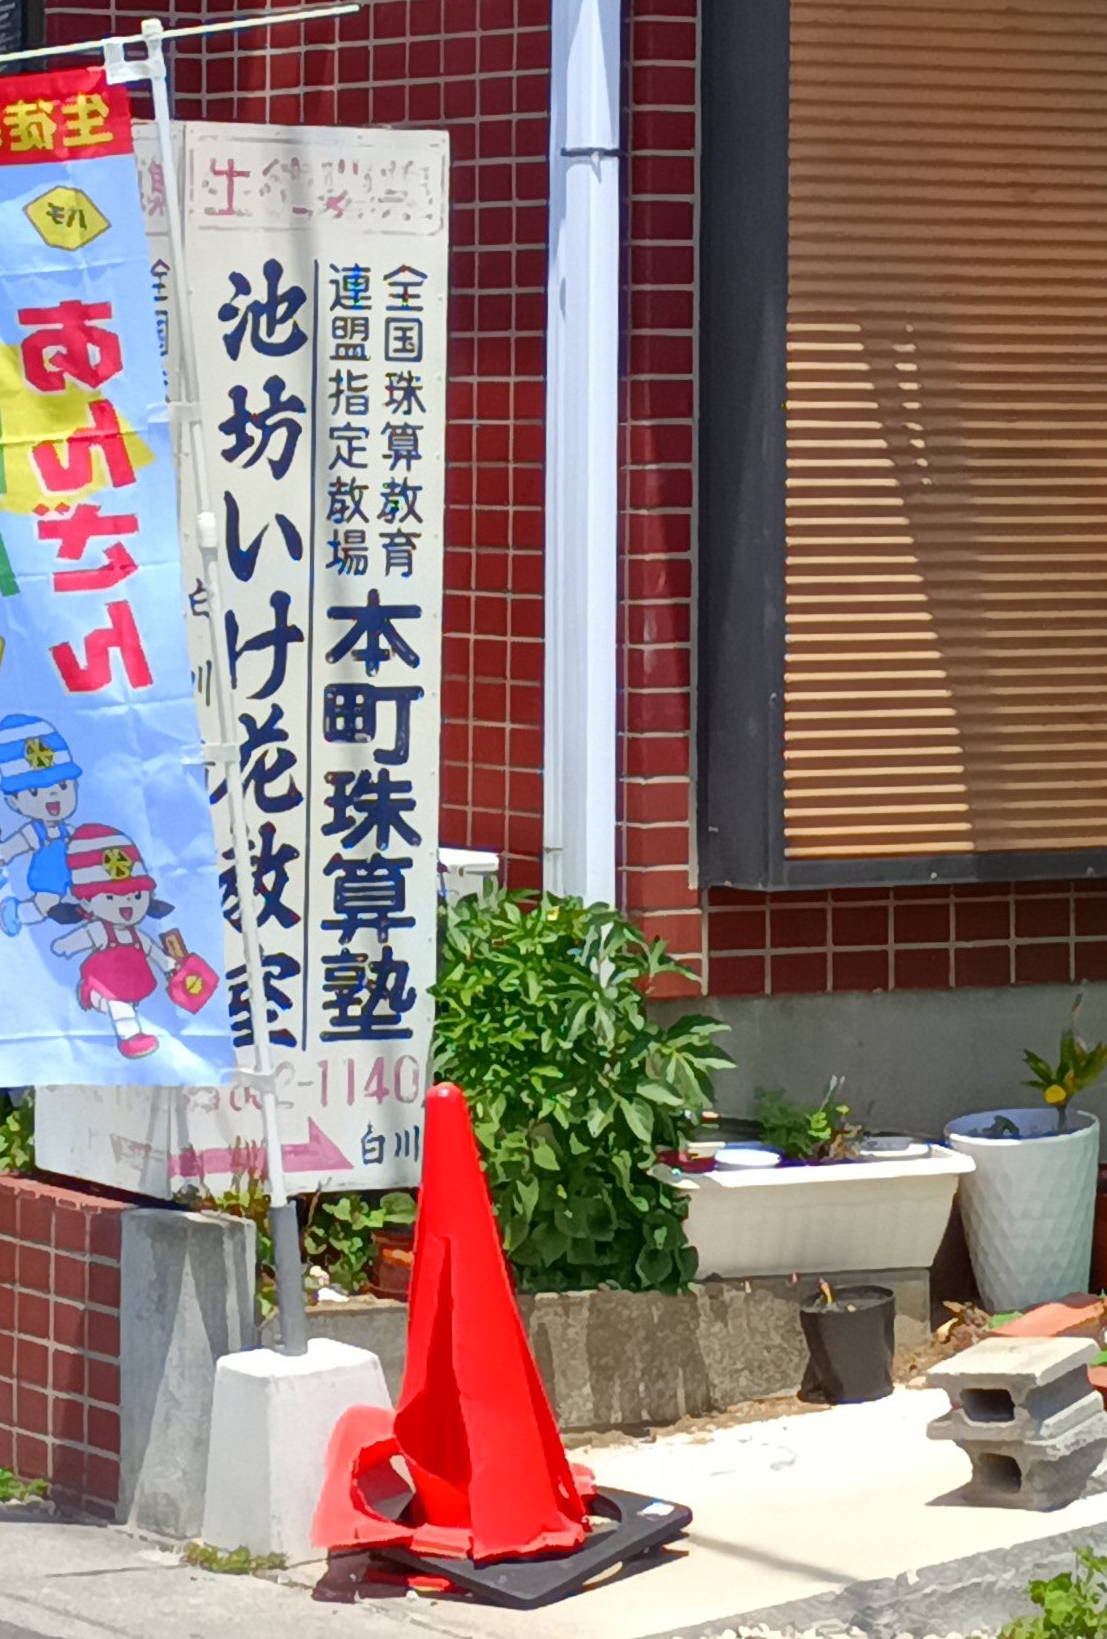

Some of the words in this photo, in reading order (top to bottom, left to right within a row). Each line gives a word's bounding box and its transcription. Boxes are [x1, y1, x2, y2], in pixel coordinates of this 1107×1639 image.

[325, 263, 373, 576] 連盟指定教場
[376, 264, 429, 578] 全国珠算教育
[210, 258, 310, 1050] 池坊いけ花教室
[319, 588, 426, 1043] 本町珠算塾
[360, 1123, 421, 1166] 白川
